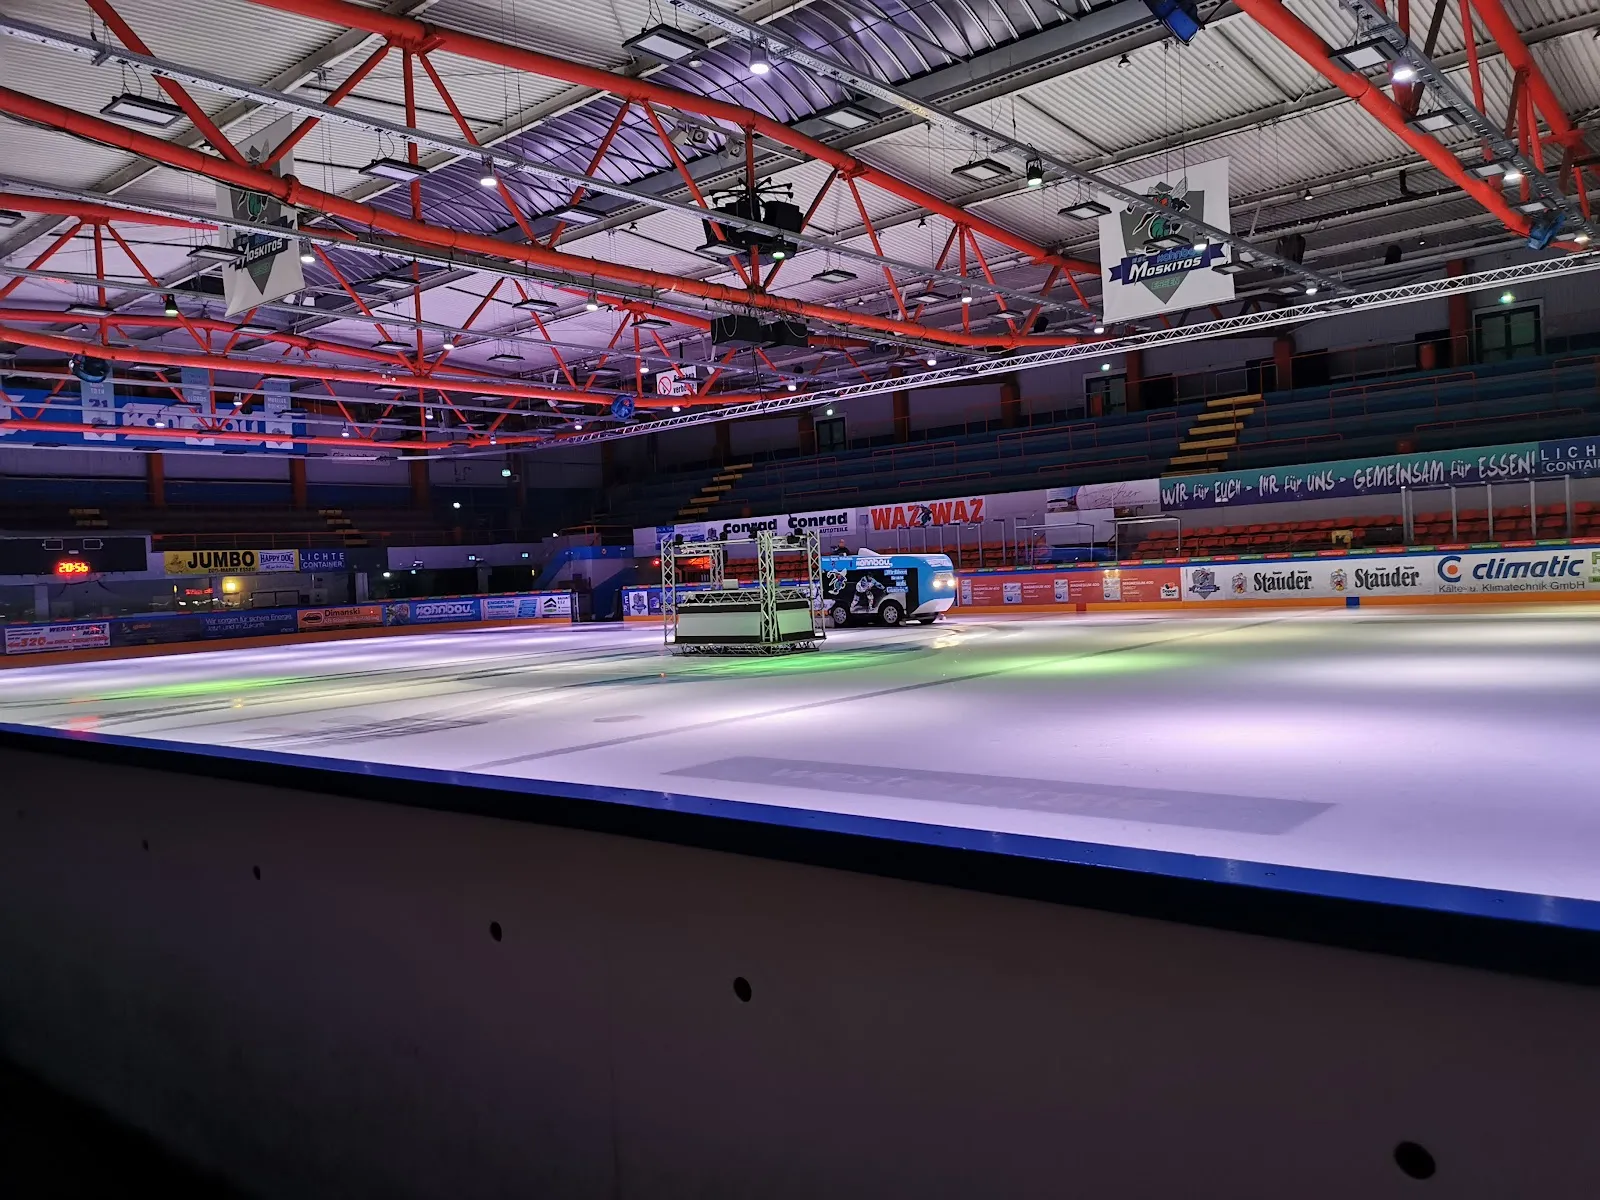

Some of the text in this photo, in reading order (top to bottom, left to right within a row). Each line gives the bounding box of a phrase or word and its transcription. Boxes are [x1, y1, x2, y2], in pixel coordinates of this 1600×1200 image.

[1128, 257, 1203, 286] MOSKITOS
[1546, 459, 1600, 472] CONTAI
[1162, 483, 1189, 505] WIR
[1193, 484, 1210, 501] für
[1214, 479, 1241, 503] EUCH
[1259, 474, 1280, 497] IHR
[1284, 476, 1303, 493] für
[1307, 469, 1336, 492] UNS
[1353, 459, 1445, 490] GEMEINSAM
[1450, 460, 1472, 480] für
[1478, 450, 1536, 479] ESSEN!
[871, 498, 984, 531] WAZ WAZ
[187, 551, 255, 569] JUMBO
[300, 552, 345, 561] LICHTE
[302, 561, 344, 569] CONTAINER
[1472, 555, 1584, 580] climatic
[1482, 582, 1548, 592] Klimatechnik
[1550, 580, 1585, 590] GmbH
